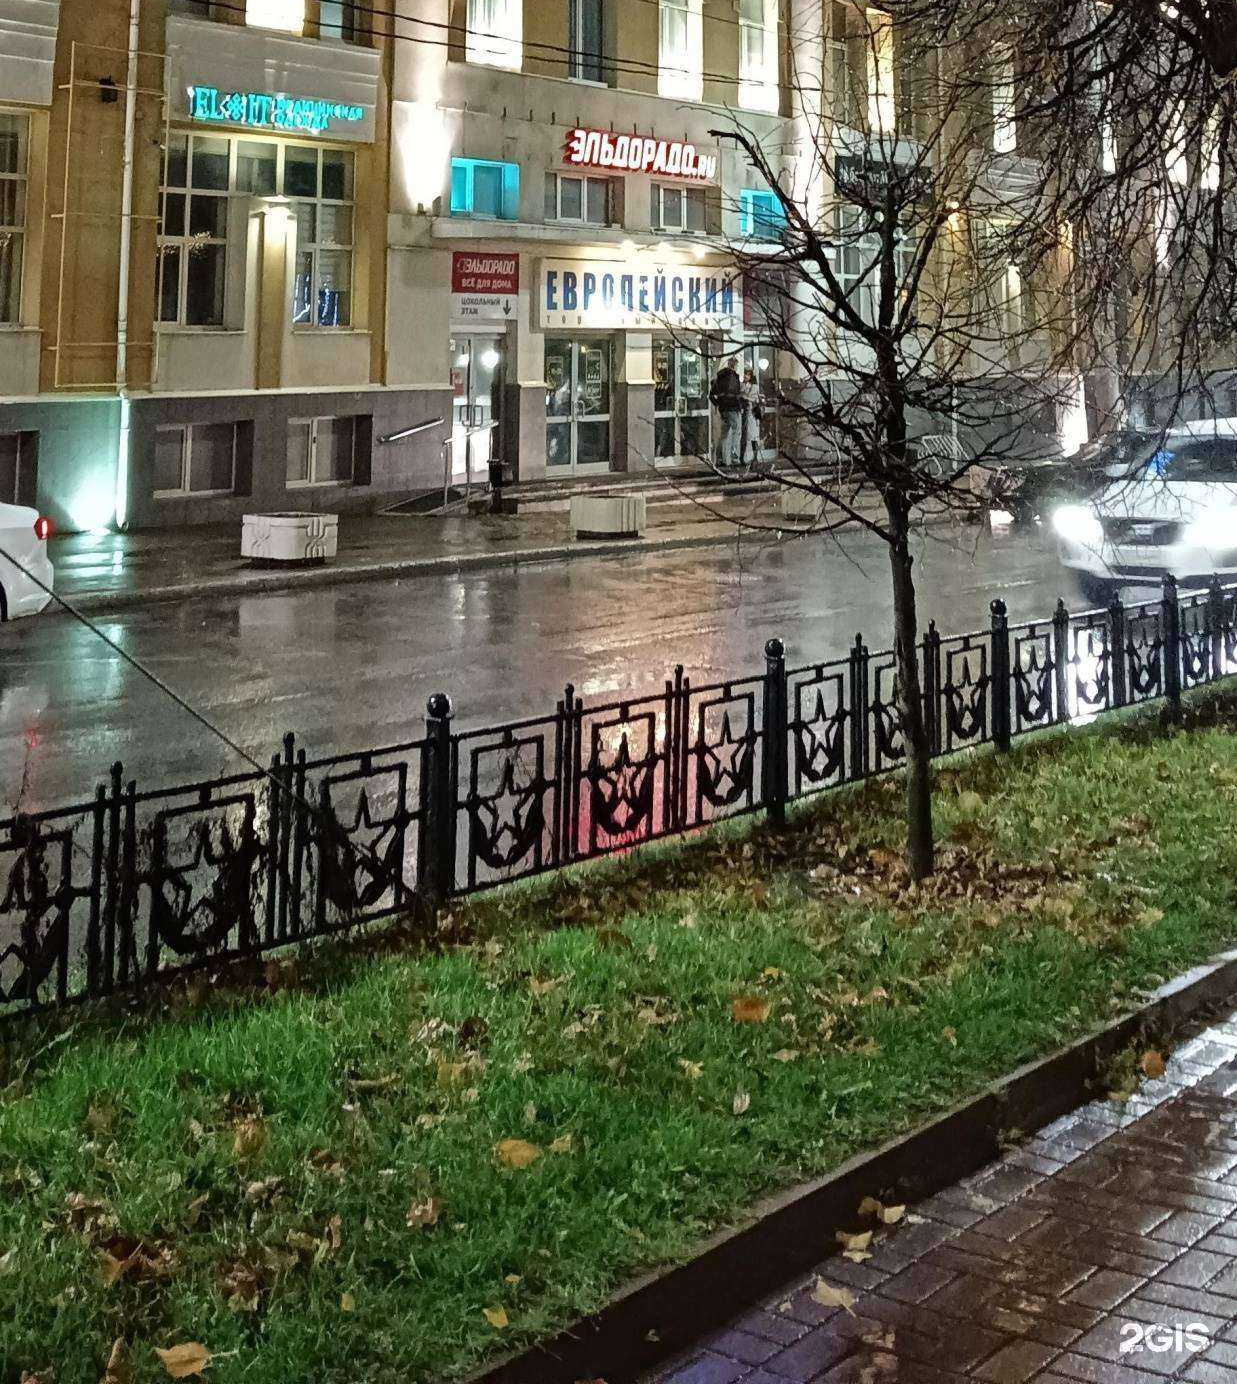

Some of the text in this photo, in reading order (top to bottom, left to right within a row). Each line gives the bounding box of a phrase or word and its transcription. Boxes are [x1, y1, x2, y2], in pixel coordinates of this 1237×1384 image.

[477, 278, 490, 290] ДЛЯ
[492, 279, 512, 290] ДОМА
[547, 268, 733, 314] ЕВРОПЕЙСКИЙ
